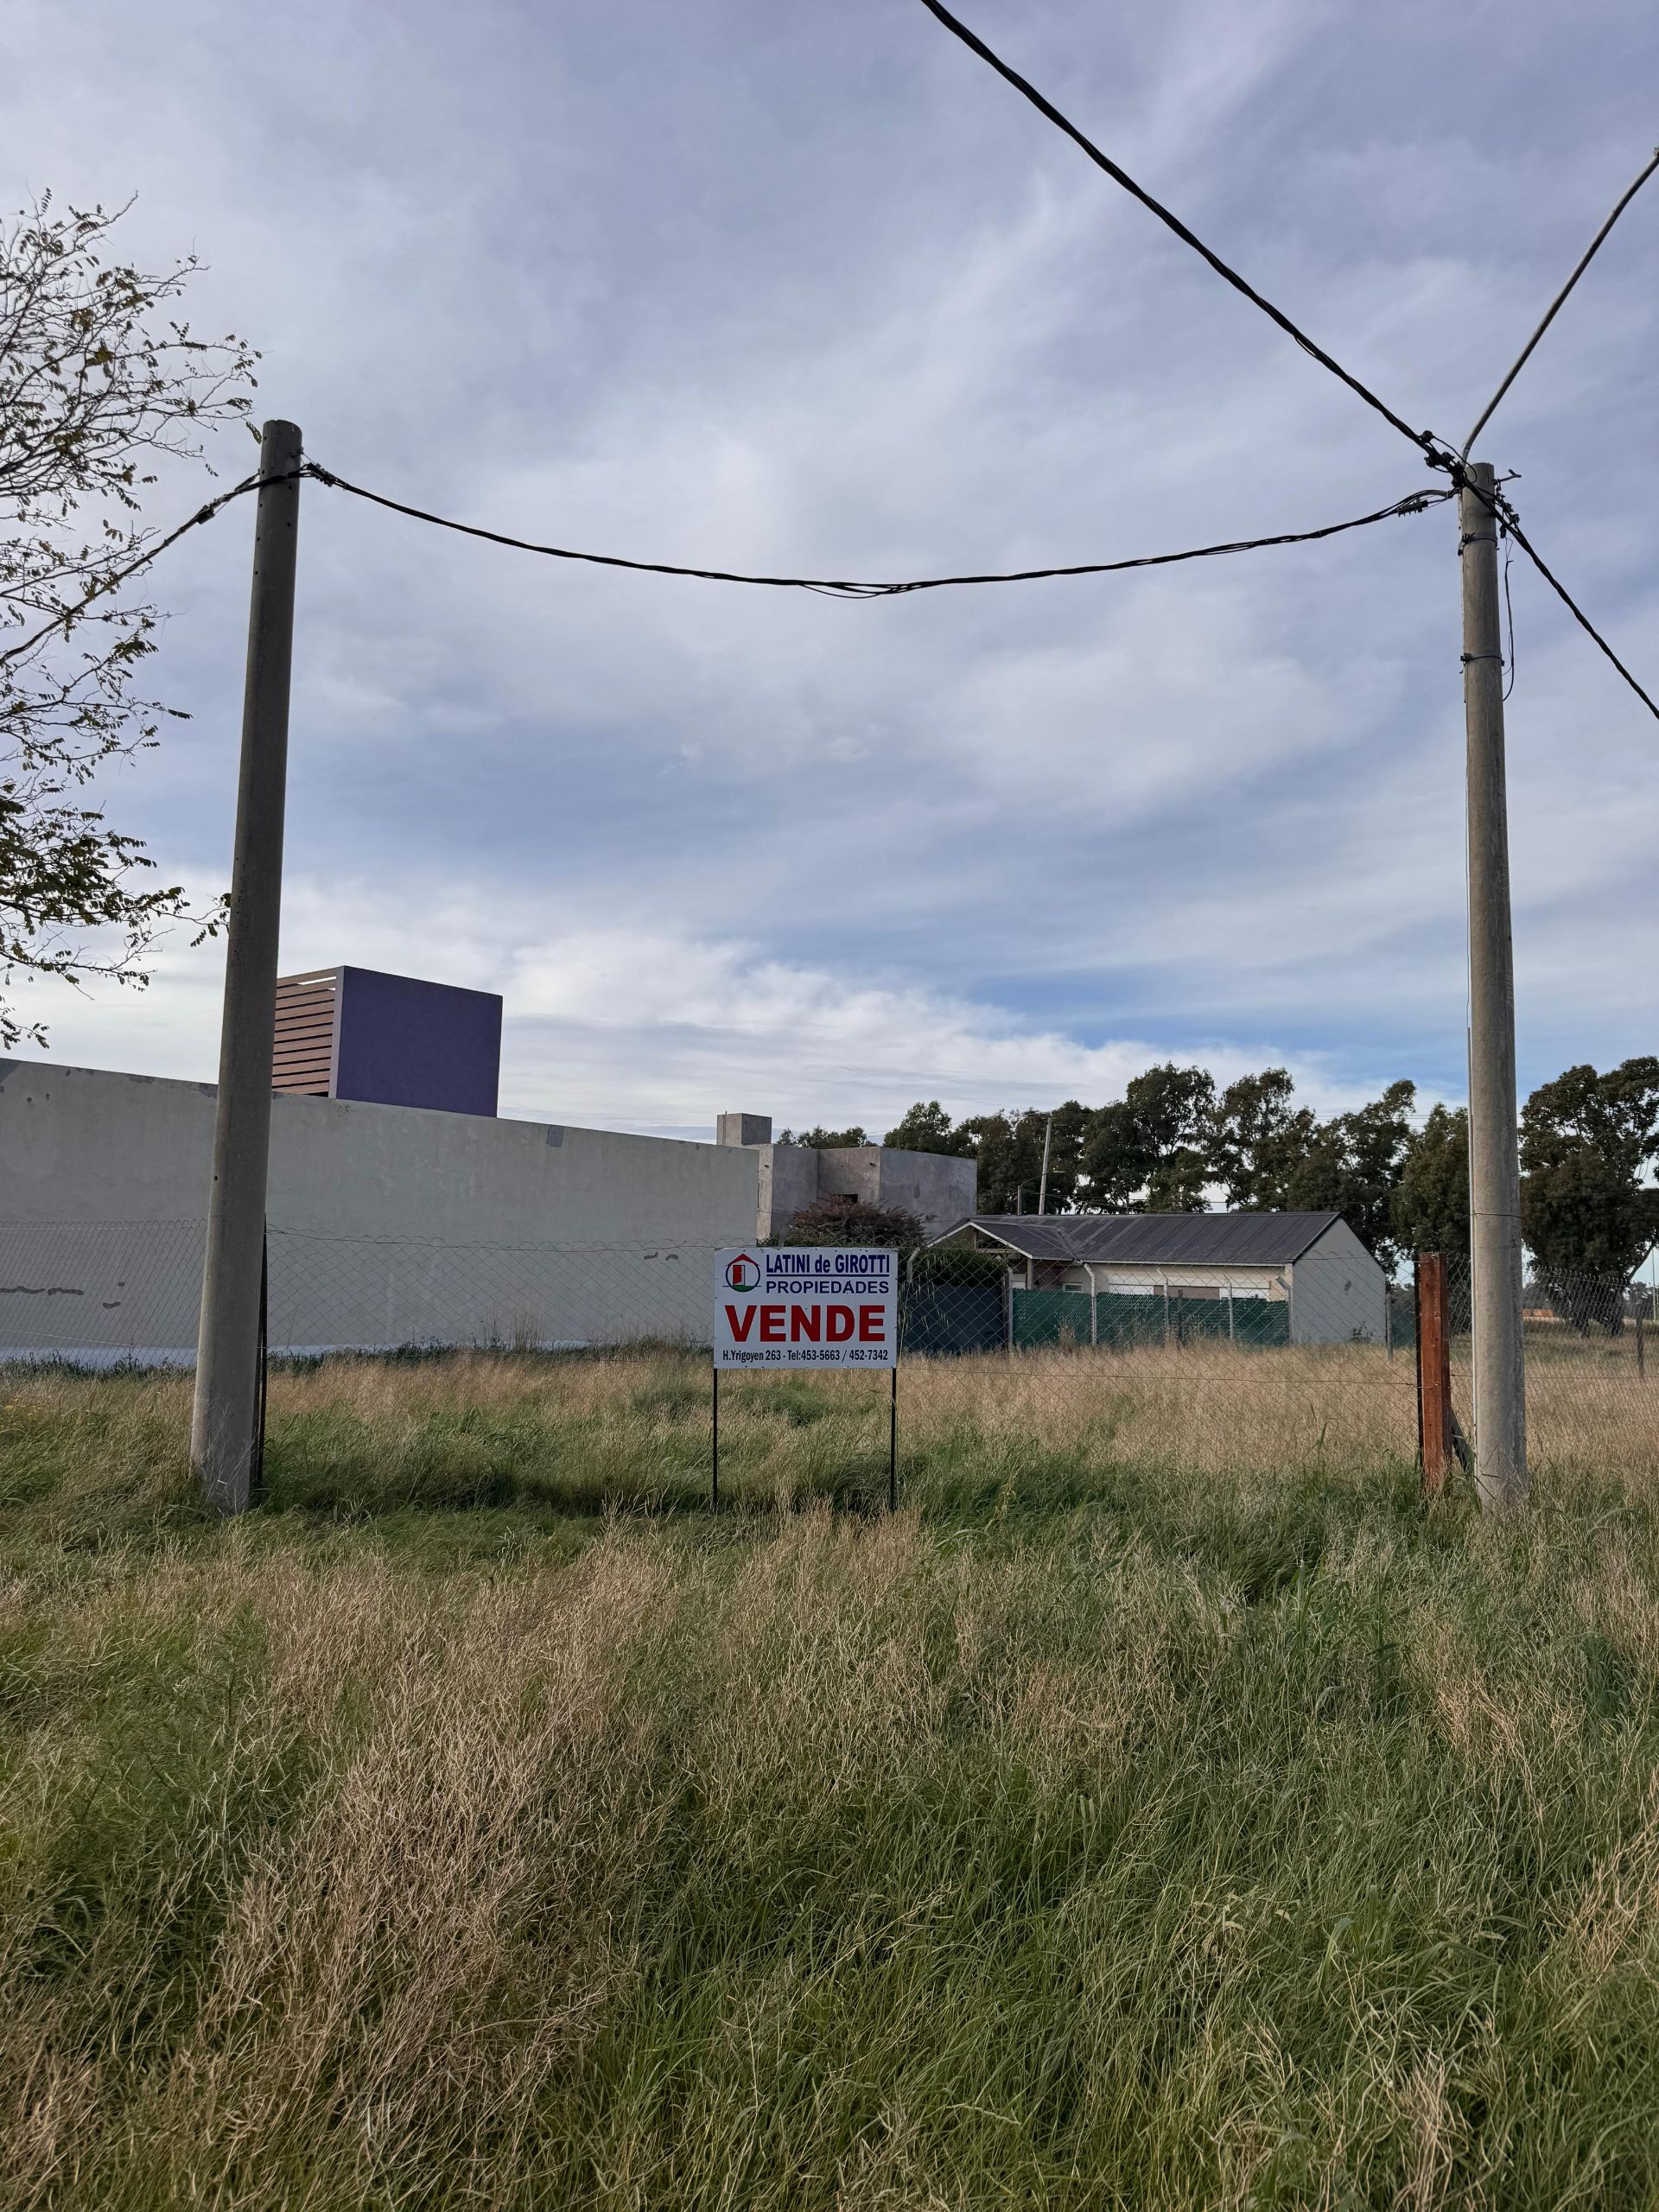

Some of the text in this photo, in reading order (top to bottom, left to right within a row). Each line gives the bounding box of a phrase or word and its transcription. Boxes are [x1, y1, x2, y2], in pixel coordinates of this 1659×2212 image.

[766, 1255, 889, 1273] LATINI de GIROTTI
[766, 1281, 889, 1294] PROPIEDADES
[724, 1305, 885, 1342] VENDE
[722, 1350, 764, 1363] H.Yrigoyen
[766, 1350, 781, 1361] 263
[787, 1350, 840, 1361] Tel:453-5663
[842, 1350, 847, 1363] /
[849, 1350, 888, 1361] 452-7342
